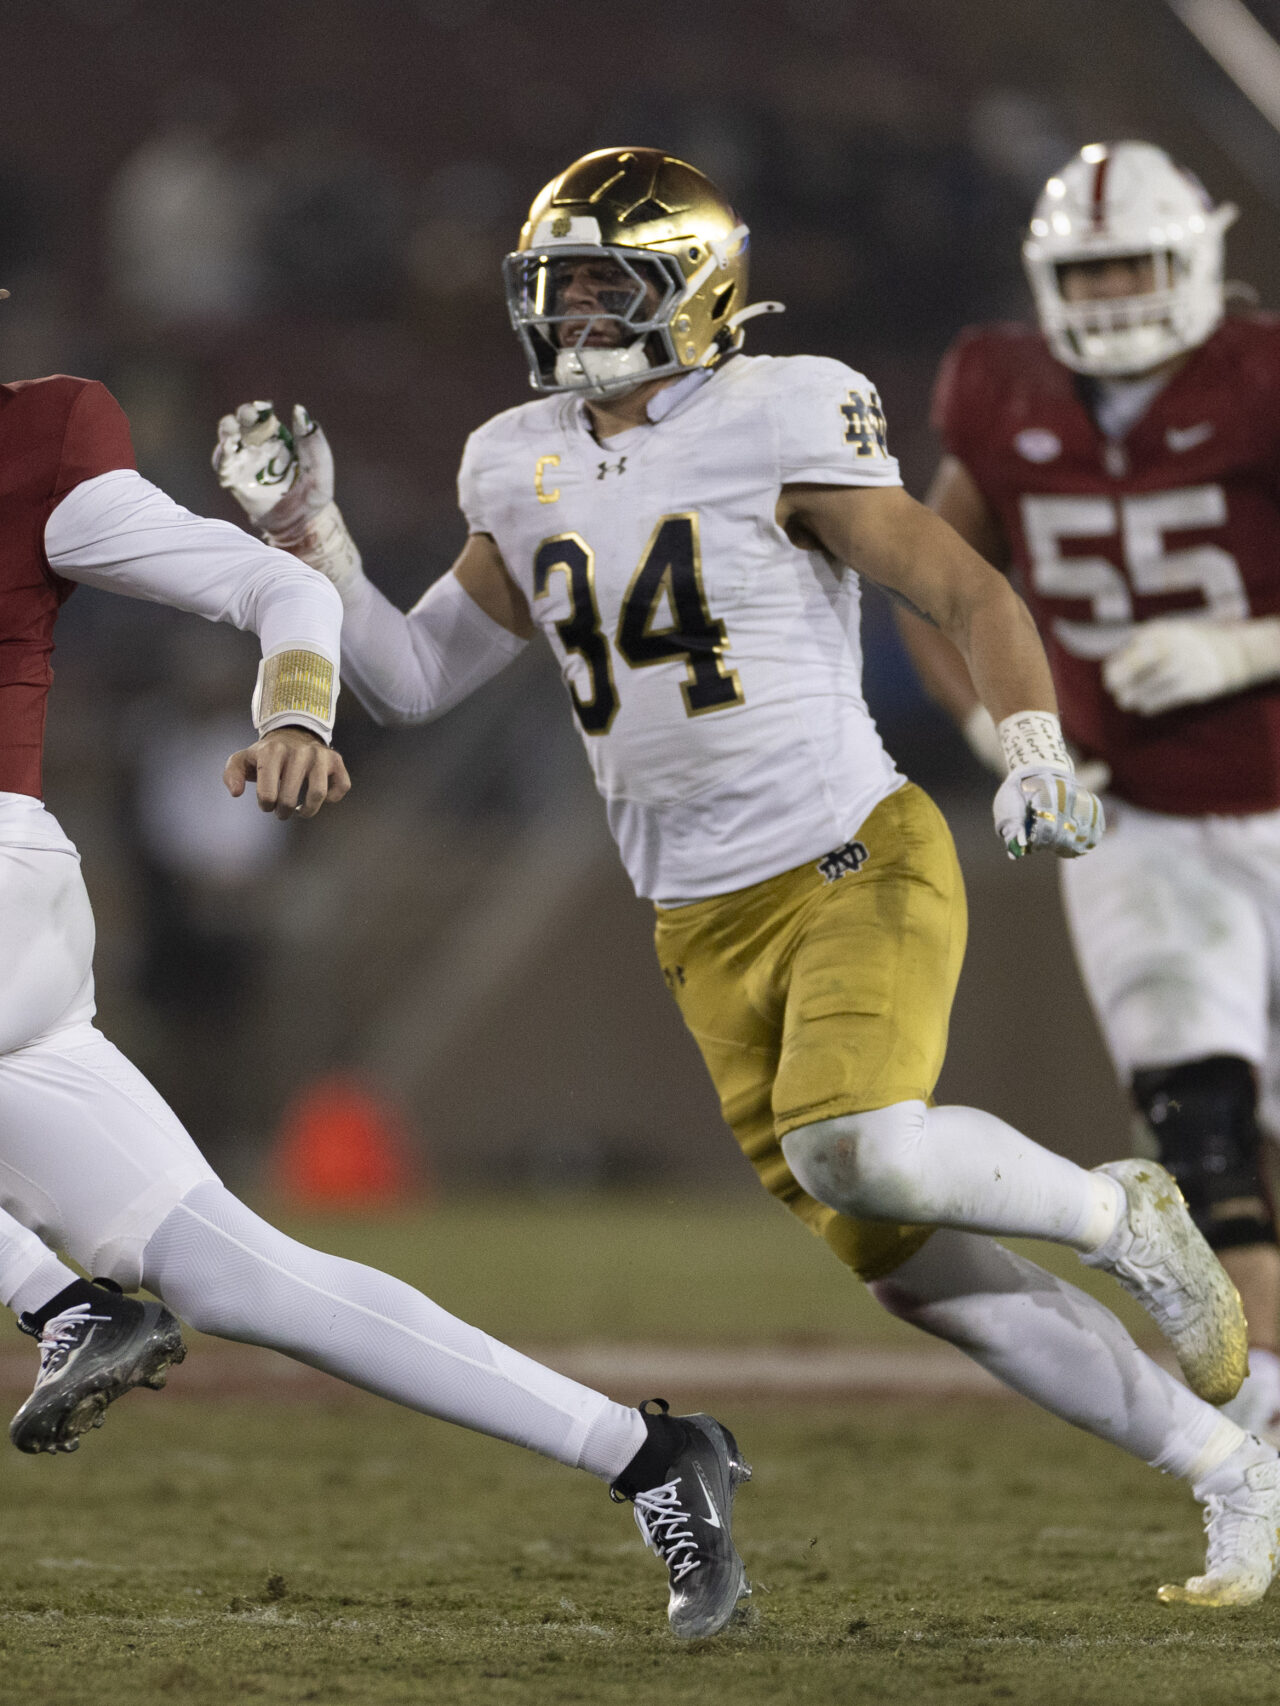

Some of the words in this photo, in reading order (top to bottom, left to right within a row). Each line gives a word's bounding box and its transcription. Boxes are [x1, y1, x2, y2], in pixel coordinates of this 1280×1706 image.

[534, 454, 561, 504] C
[532, 511, 747, 737] 34
[1022, 483, 1250, 660] 55
